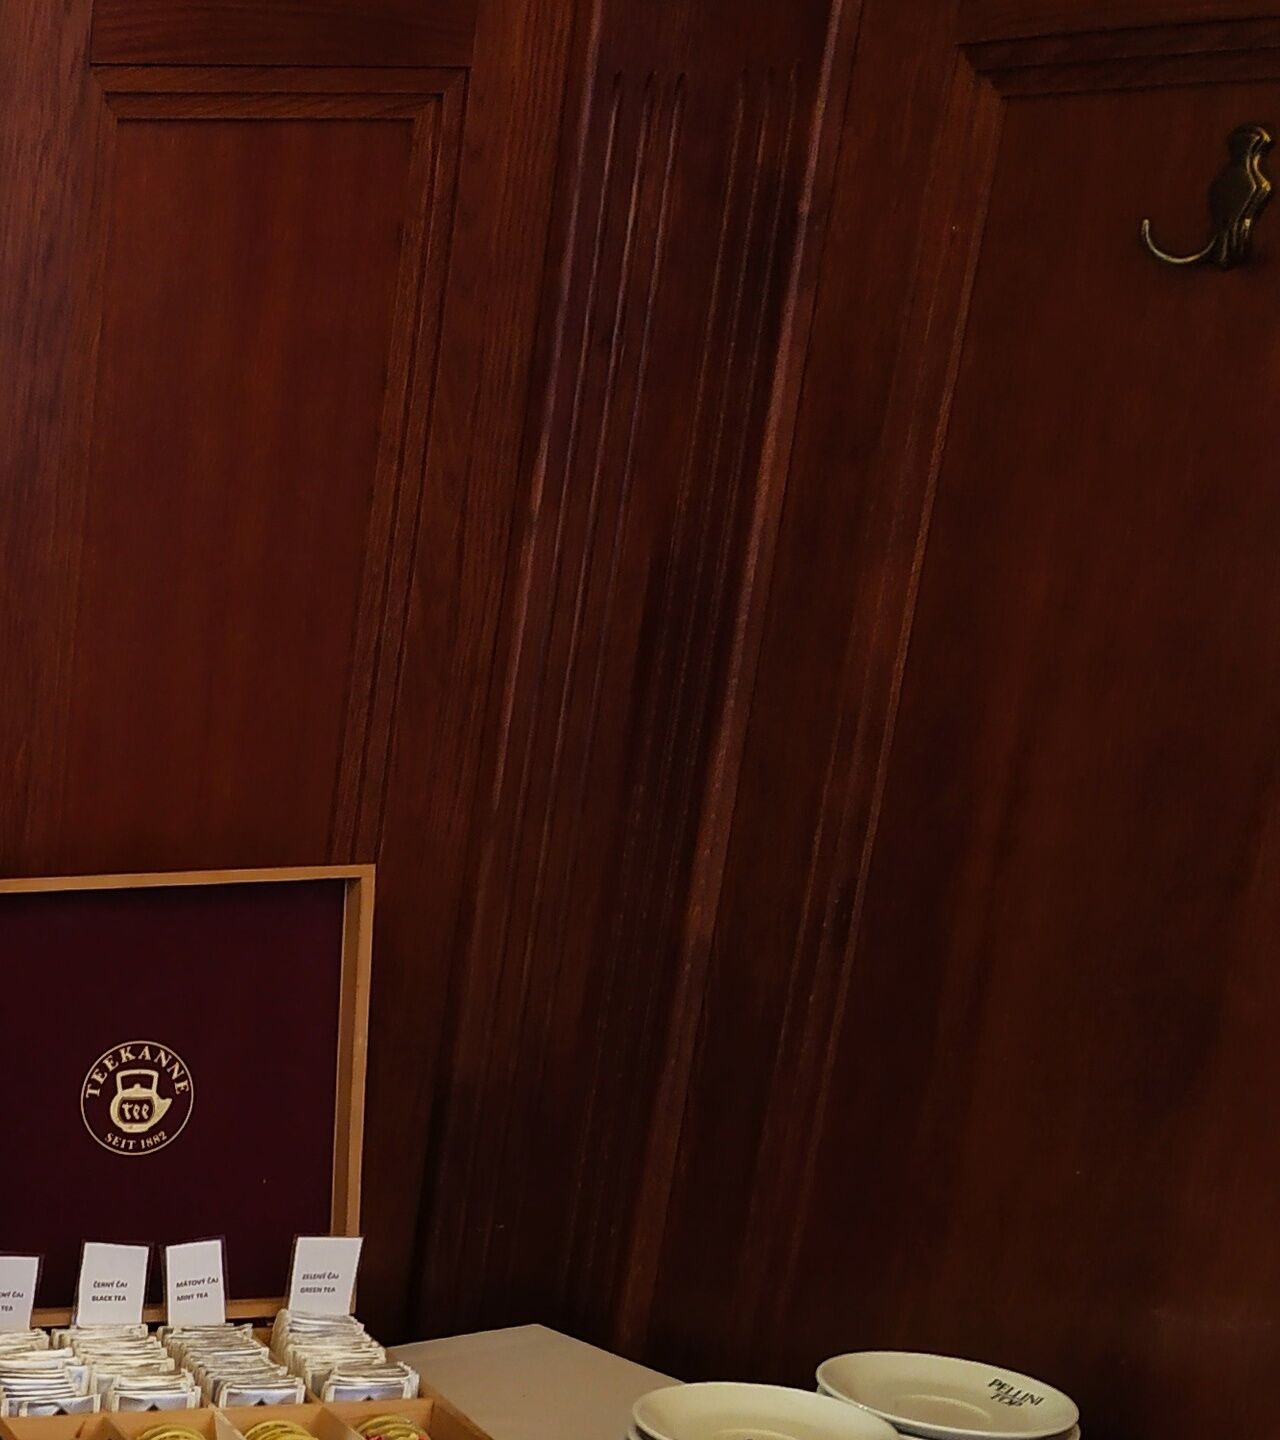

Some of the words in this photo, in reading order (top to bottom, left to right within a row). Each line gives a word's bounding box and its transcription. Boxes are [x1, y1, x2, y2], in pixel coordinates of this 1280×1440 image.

[85, 1046, 189, 1098] TEEKANNE
[105, 1132, 136, 1149] SEIT
[93, 1280, 115, 1288] ČERNÝ
[116, 1280, 128, 1288] ČAJ
[176, 1278, 206, 1288] MÁTOVÝ
[988, 1378, 1044, 1405] PELLINI
